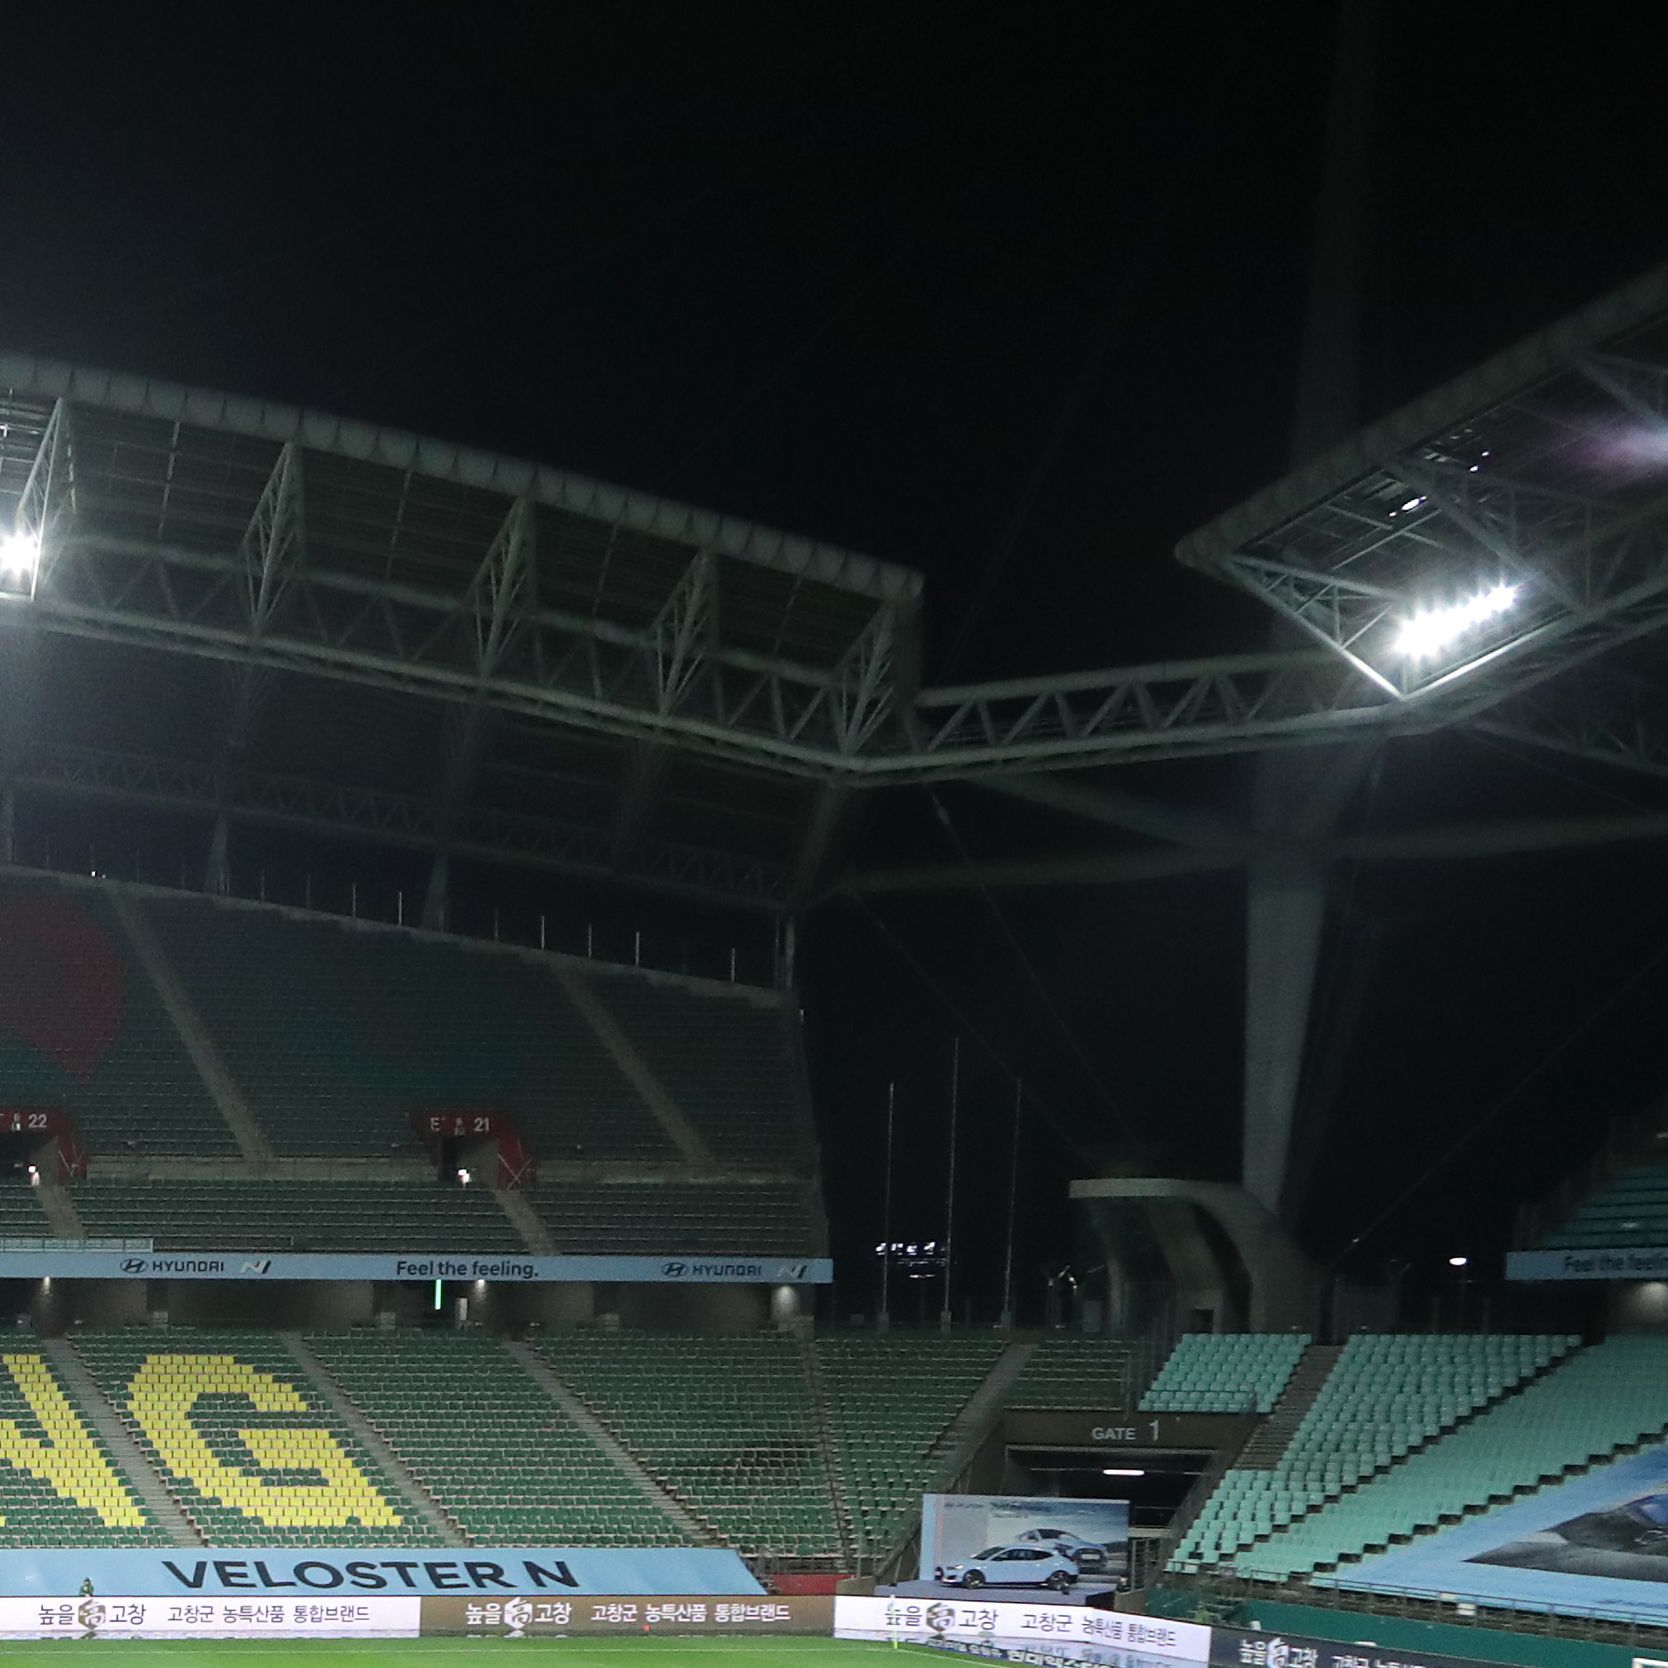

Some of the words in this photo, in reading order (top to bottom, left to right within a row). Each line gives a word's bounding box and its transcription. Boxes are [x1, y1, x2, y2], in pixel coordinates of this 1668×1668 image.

[28, 1113, 48, 1127] 22
[473, 1117, 489, 1131] 21
[152, 1260, 225, 1272] HYUNDAI
[396, 1259, 434, 1275] Feel
[438, 1259, 467, 1275] the
[471, 1259, 539, 1280] feeling.
[693, 1265, 761, 1277] HYUNDAI
[1092, 1427, 1136, 1441] GATE
[1149, 1420, 1160, 1441] 1
[162, 1560, 517, 1590] VELOSTER
[515, 1560, 581, 1590] N
[168, 1604, 214, 1624] 고창군
[222, 1604, 284, 1624] 농특산품
[293, 1604, 369, 1624] 통합브랜드
[592, 1603, 639, 1624] 고창군
[646, 1603, 705, 1624] 농특산품
[715, 1603, 790, 1624] 통합브랜드
[1022, 1614, 1072, 1633] 고창군
